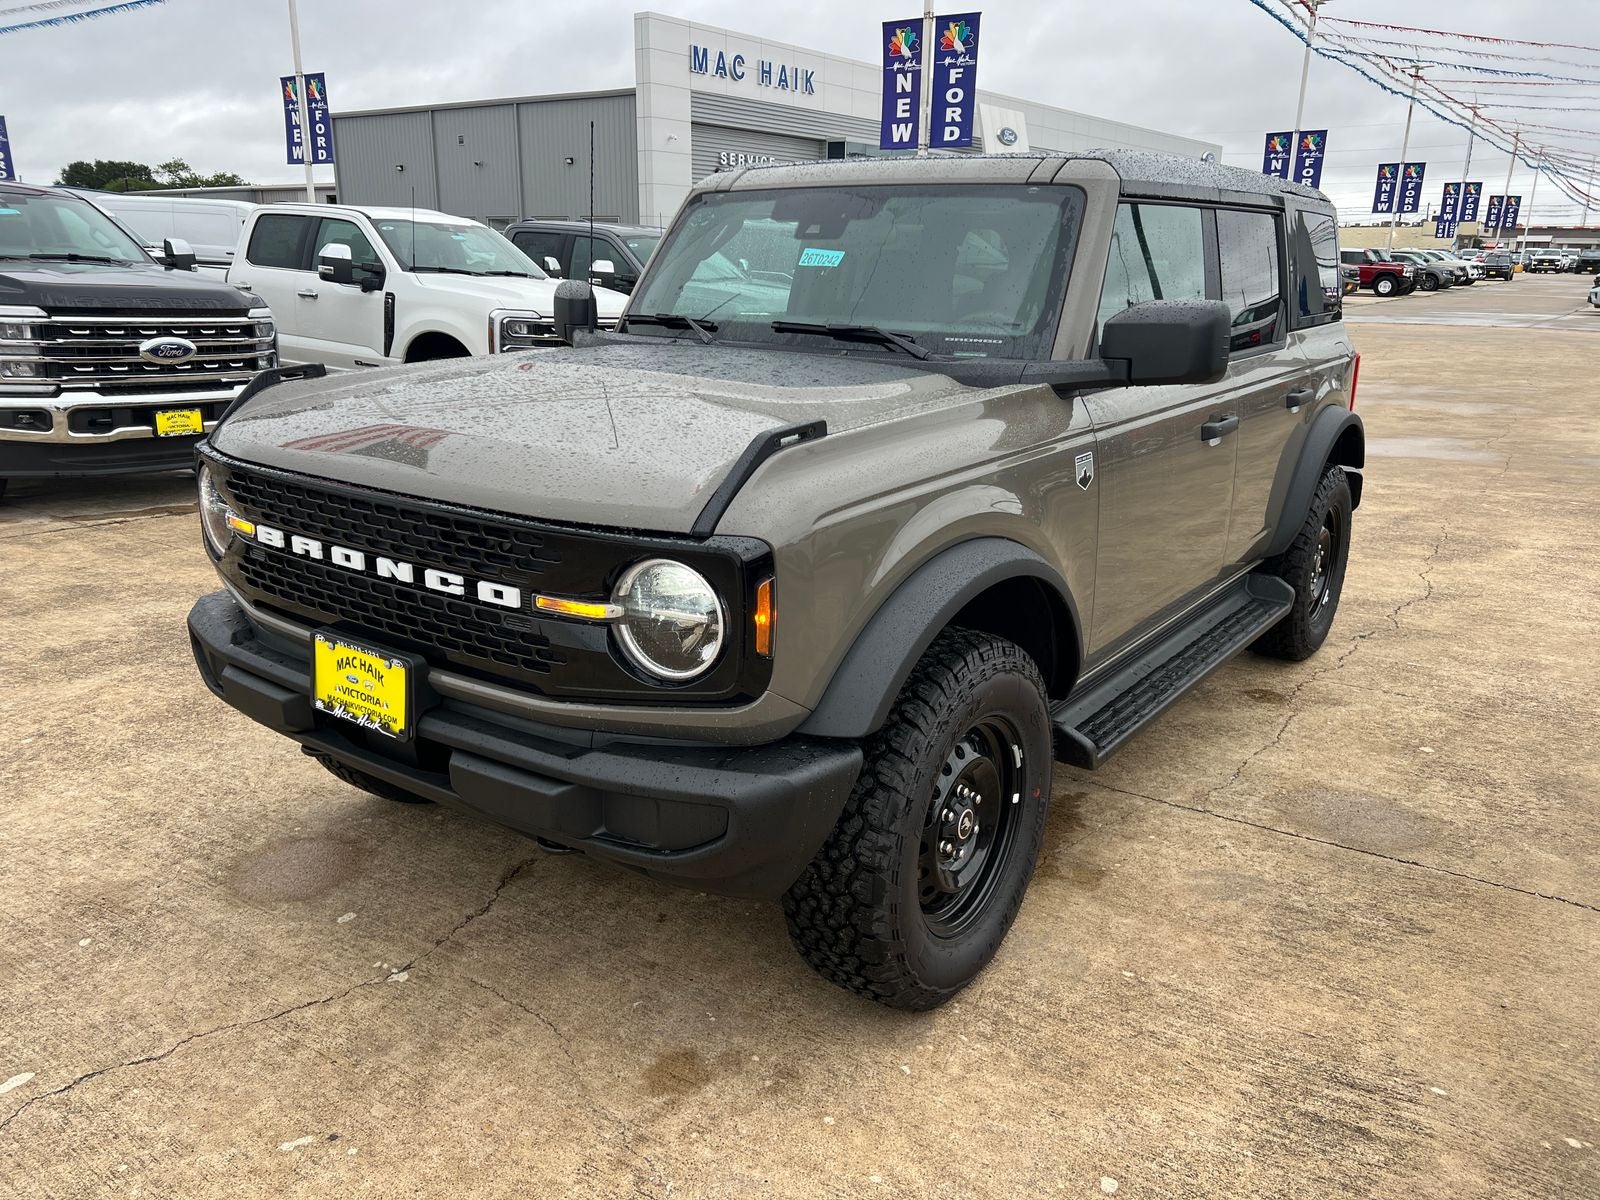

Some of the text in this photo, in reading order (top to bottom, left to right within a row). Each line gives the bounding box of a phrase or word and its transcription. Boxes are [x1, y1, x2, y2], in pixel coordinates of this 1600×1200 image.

[691, 45, 815, 94] MAC HAIK
[891, 73, 913, 143] NEW
[943, 68, 964, 142] FORD
[315, 110, 327, 160] FORD
[1377, 183, 1391, 211] NEW
[1403, 182, 1416, 212] FORD
[1443, 198, 1455, 220] NEW
[1464, 197, 1475, 221] FORD
[801, 252, 840, 266] 26T0242
[158, 344, 184, 358] Ford
[256, 524, 521, 609] BRONCO
[336, 656, 357, 672] MAC
[359, 658, 384, 687] HAIK
[341, 685, 382, 708] VICTORIA
[332, 704, 357, 722] Mac
